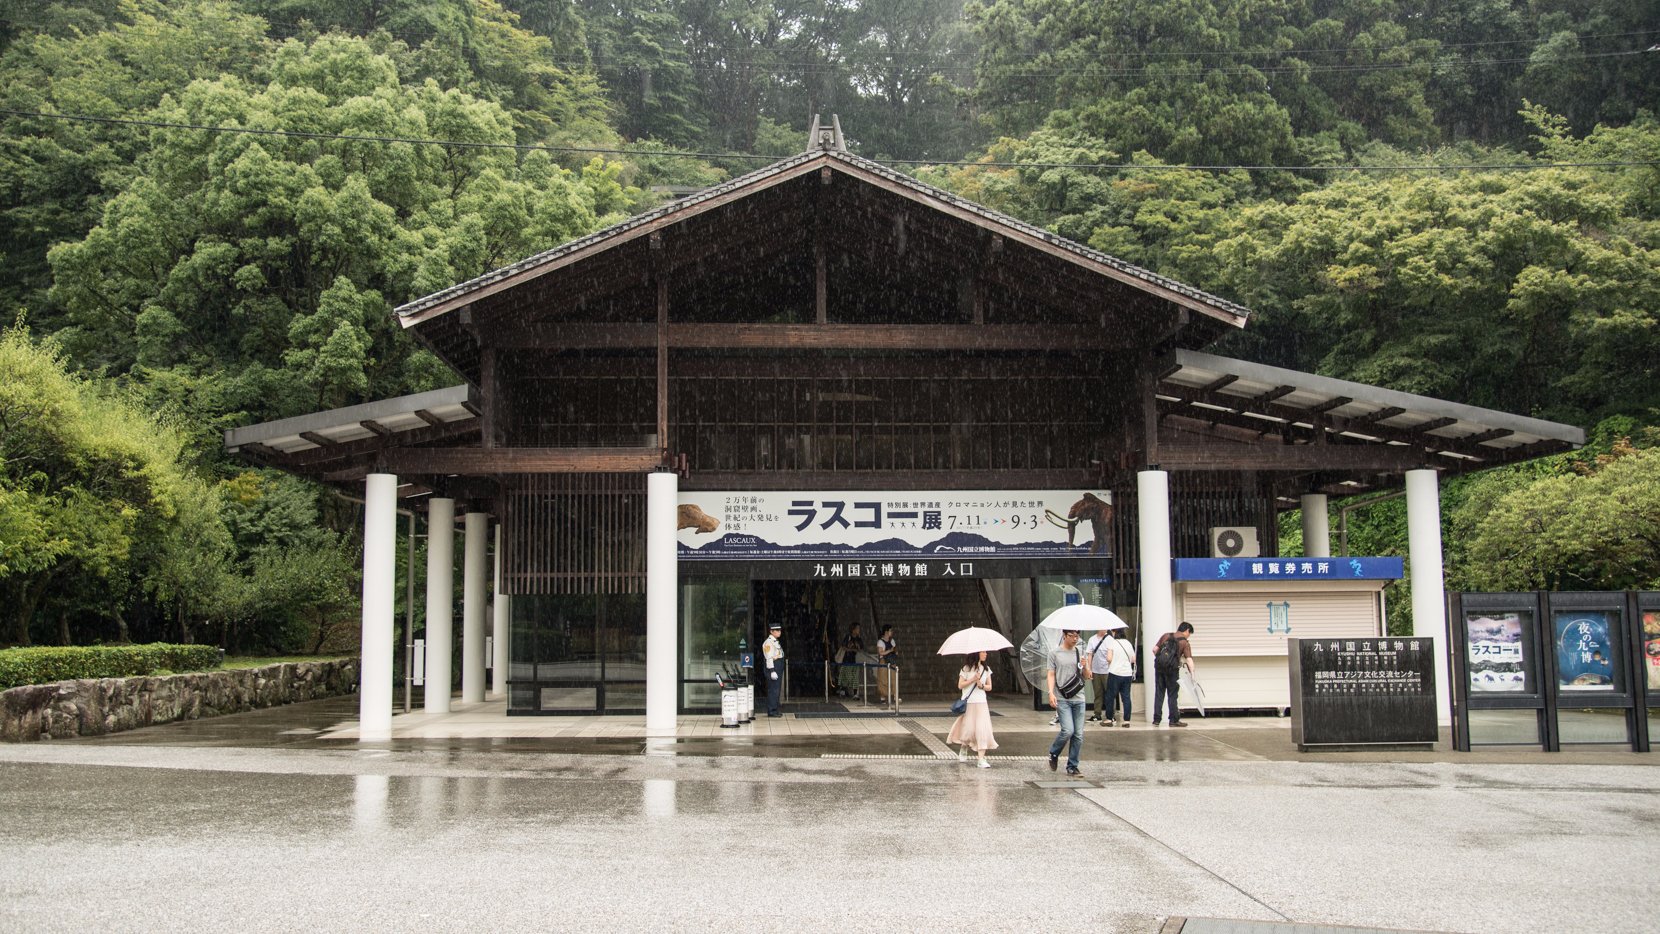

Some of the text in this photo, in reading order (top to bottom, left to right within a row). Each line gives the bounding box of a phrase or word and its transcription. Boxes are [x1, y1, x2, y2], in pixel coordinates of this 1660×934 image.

[725, 495, 765, 504] 2万年前の
[724, 504, 764, 513] 洞窟壁画、
[947, 500, 1044, 509] クロマニョン人が見た世界
[725, 513, 780, 522] 世紀の大発見を
[787, 500, 942, 532] ラスコー展
[724, 536, 758, 544] LASCAUX
[813, 562, 974, 577] 九州国立博物館 入口
[1251, 562, 1329, 575] 観覧券売所
[1313, 641, 1420, 652] 九州国立博物館
[1576, 621, 1592, 664] 夜の九博
[1314, 671, 1421, 679] 福岡県立アジア文化交流センター
